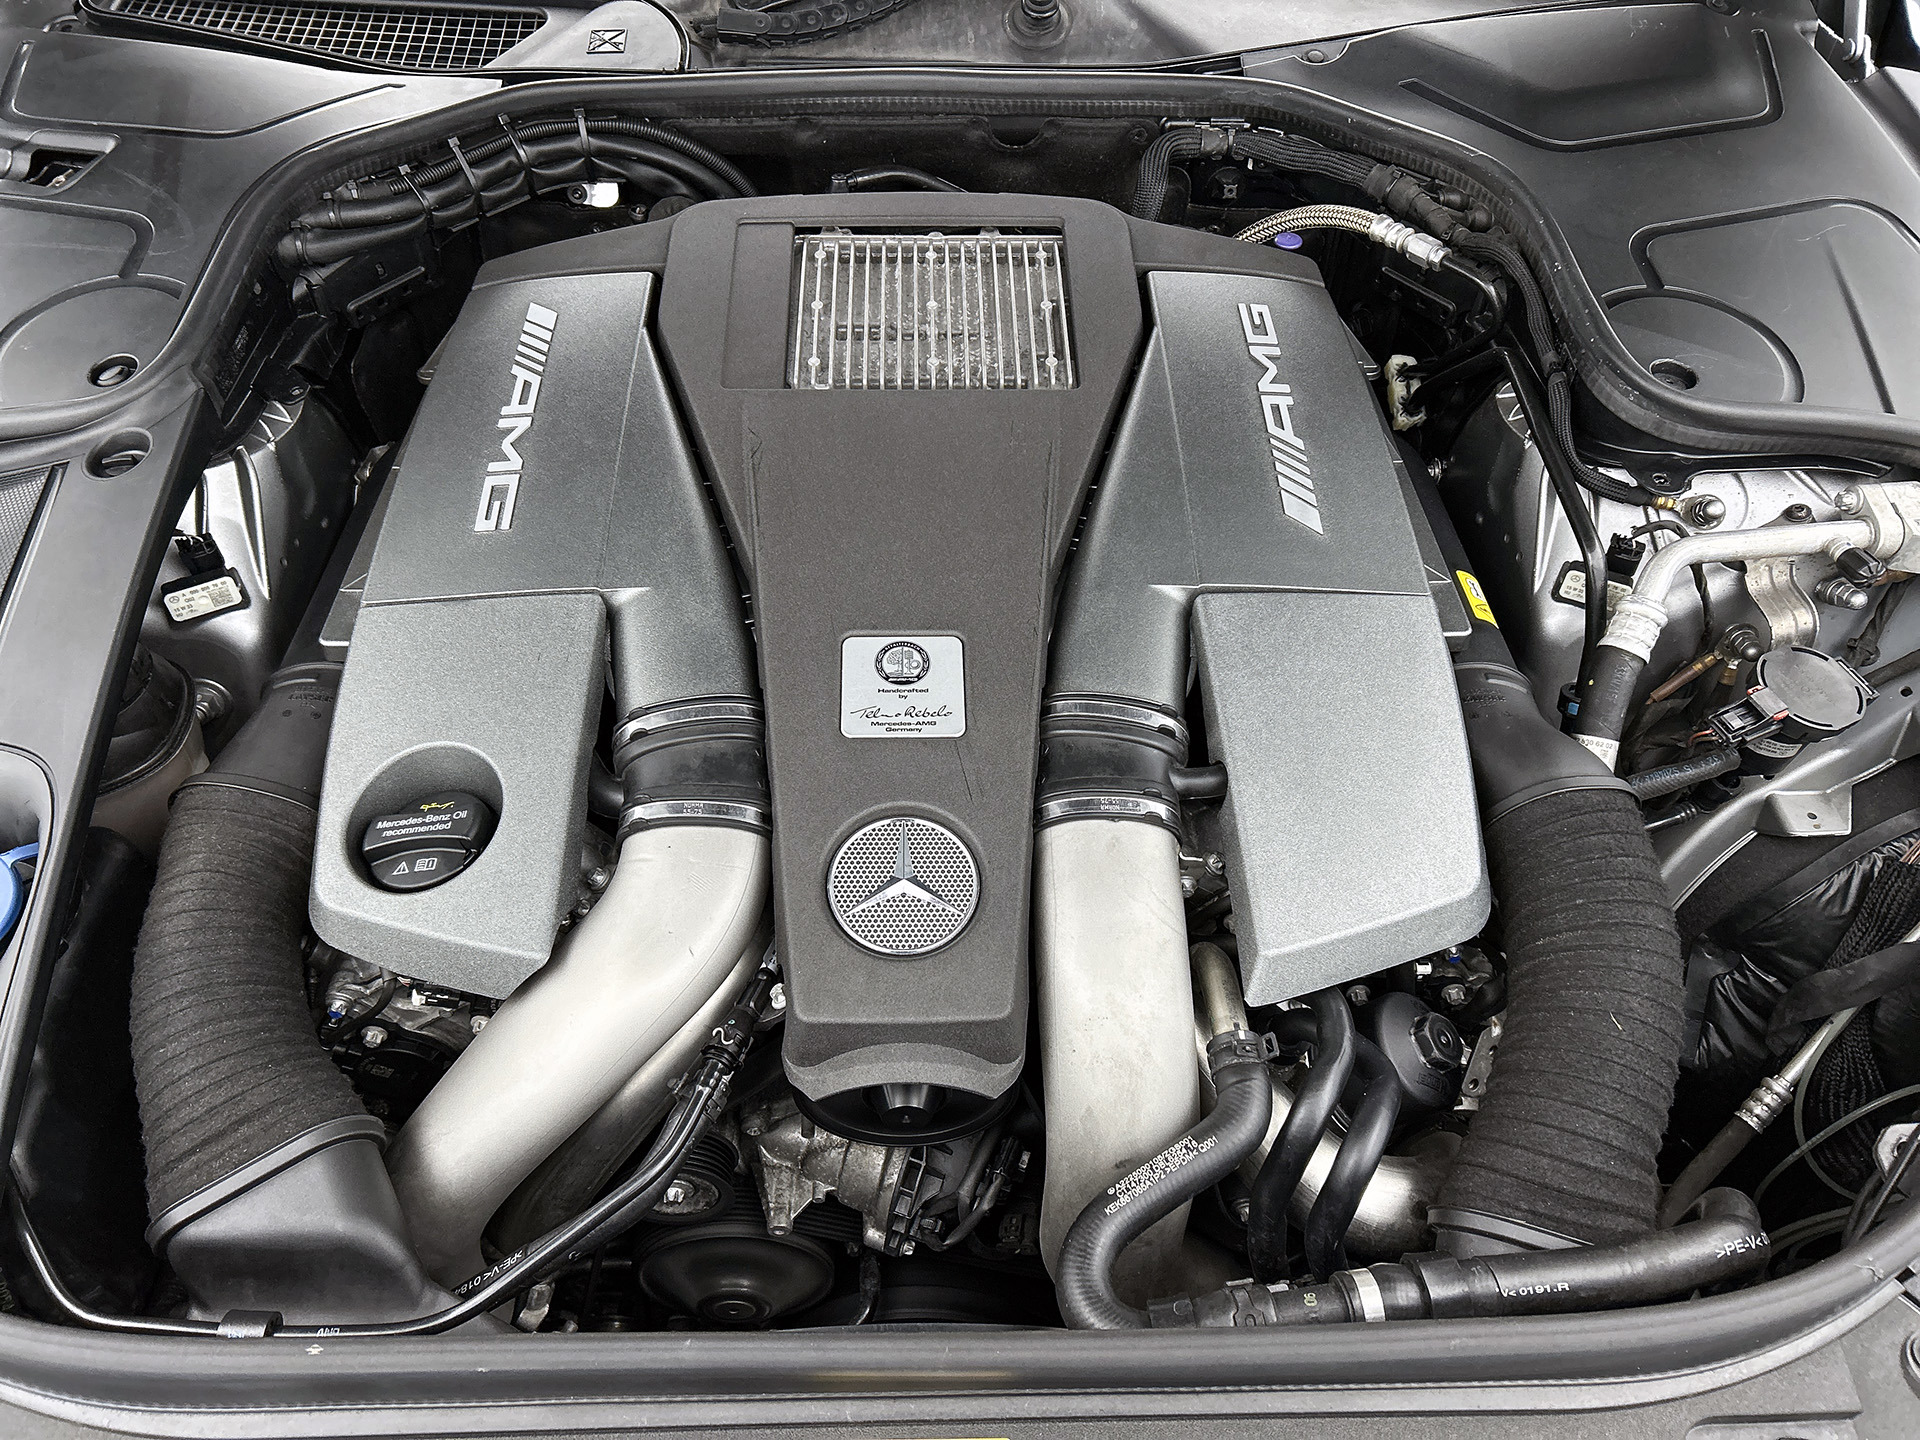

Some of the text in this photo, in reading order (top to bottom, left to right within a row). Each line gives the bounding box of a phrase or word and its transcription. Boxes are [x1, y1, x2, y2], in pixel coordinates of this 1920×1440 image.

[474, 364, 542, 532] AMG
[376, 810, 468, 829] Mercedes-Benz Oil
[382, 821, 452, 837] recommended
[1198, 1135, 1220, 1154] Q001
[1519, 1282, 1570, 1296] 0191.R
